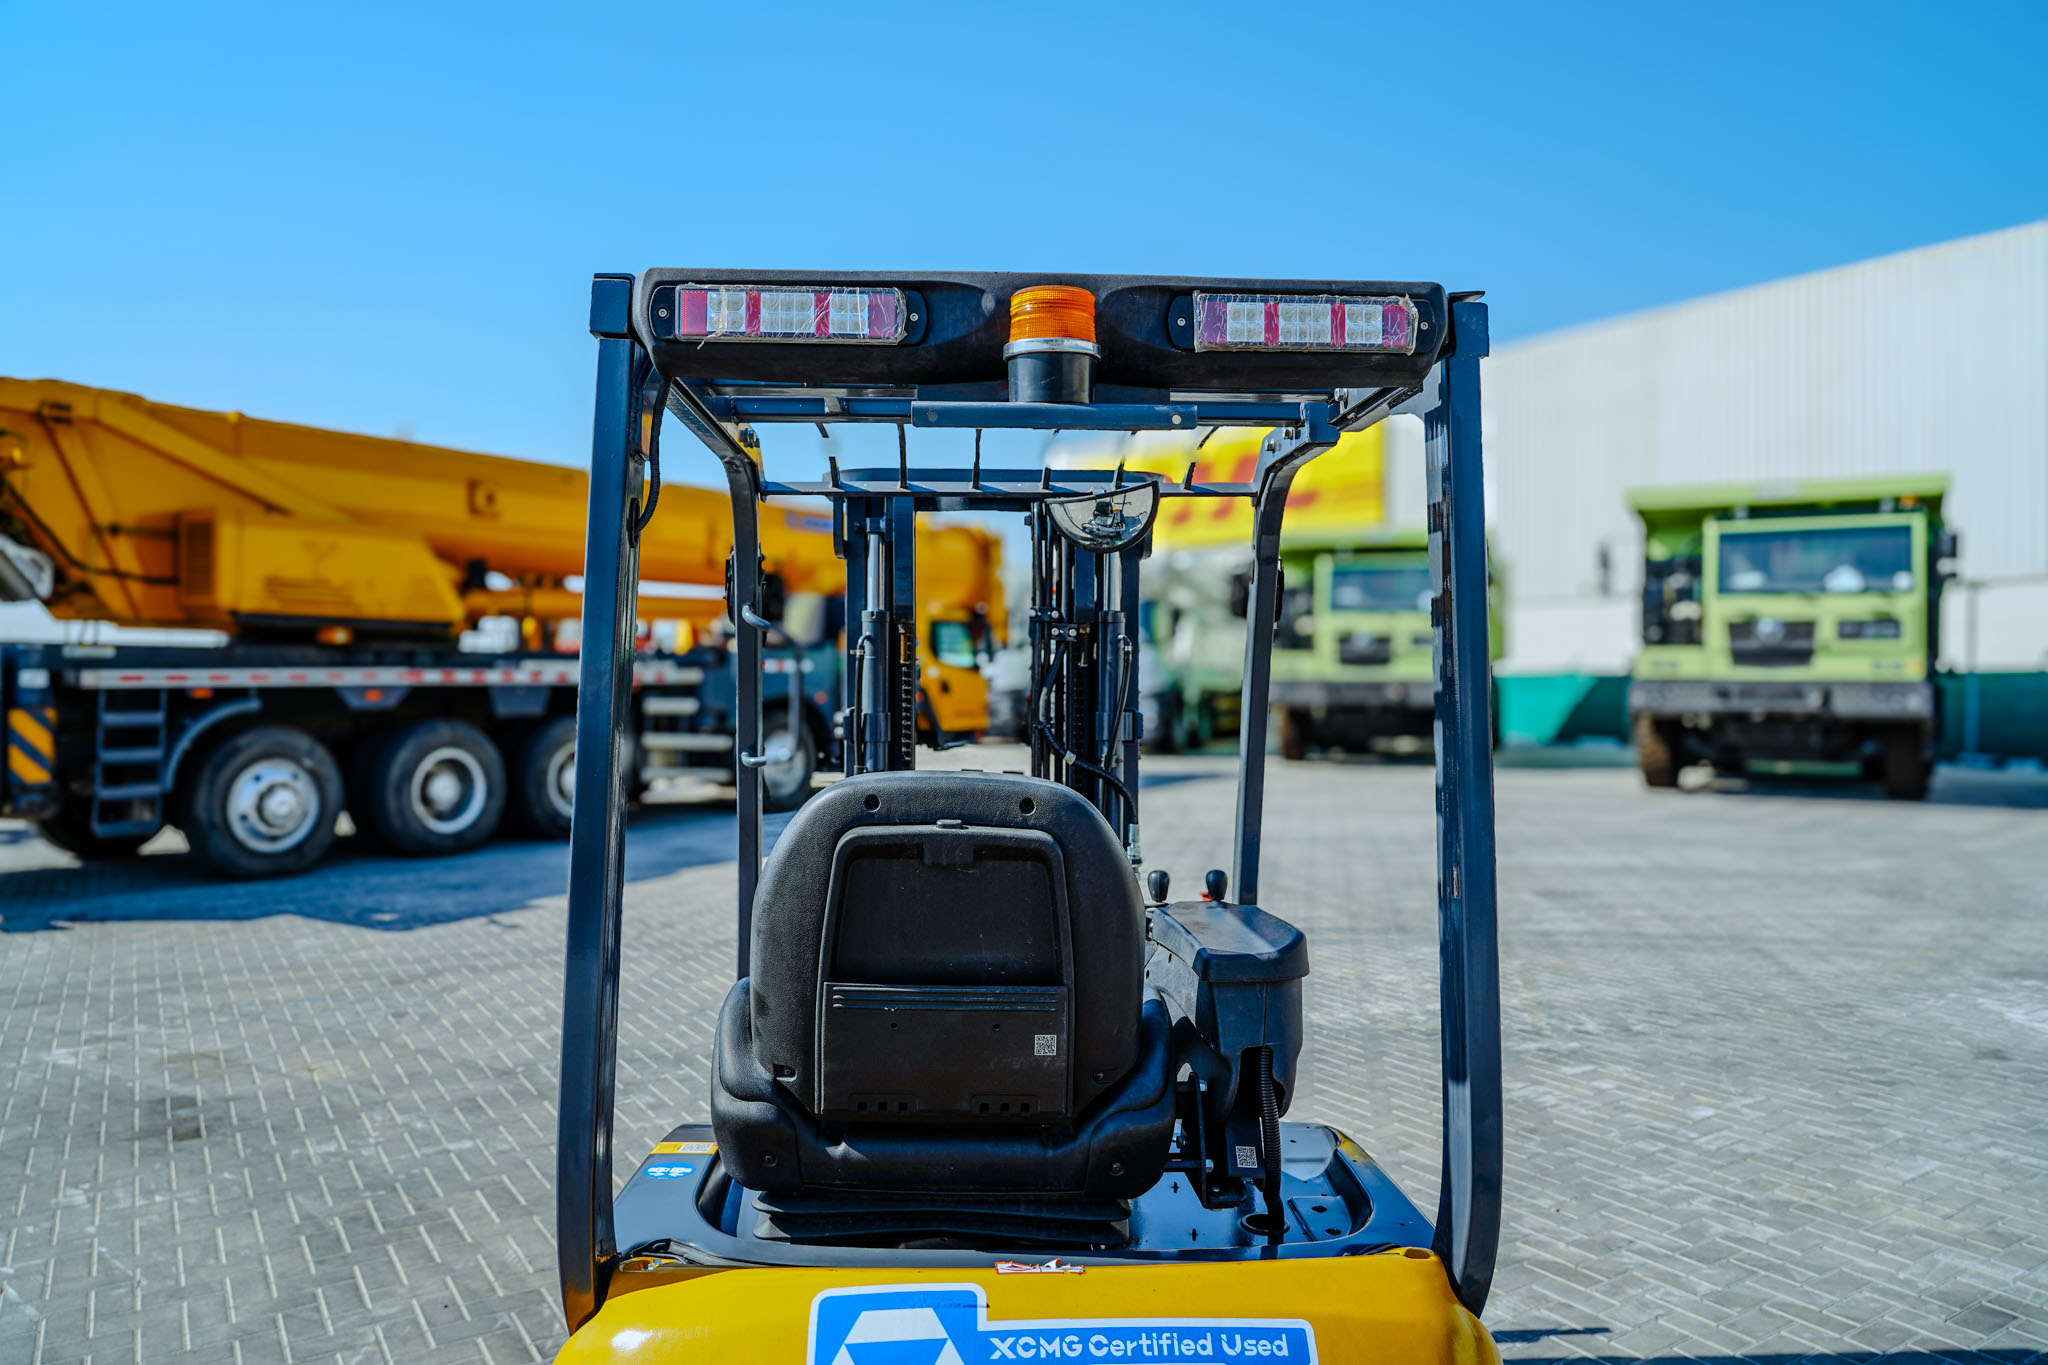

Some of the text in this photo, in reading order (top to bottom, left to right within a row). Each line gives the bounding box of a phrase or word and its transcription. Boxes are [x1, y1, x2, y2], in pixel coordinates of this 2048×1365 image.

[989, 1332, 1289, 1359] XCMG Certified Used
